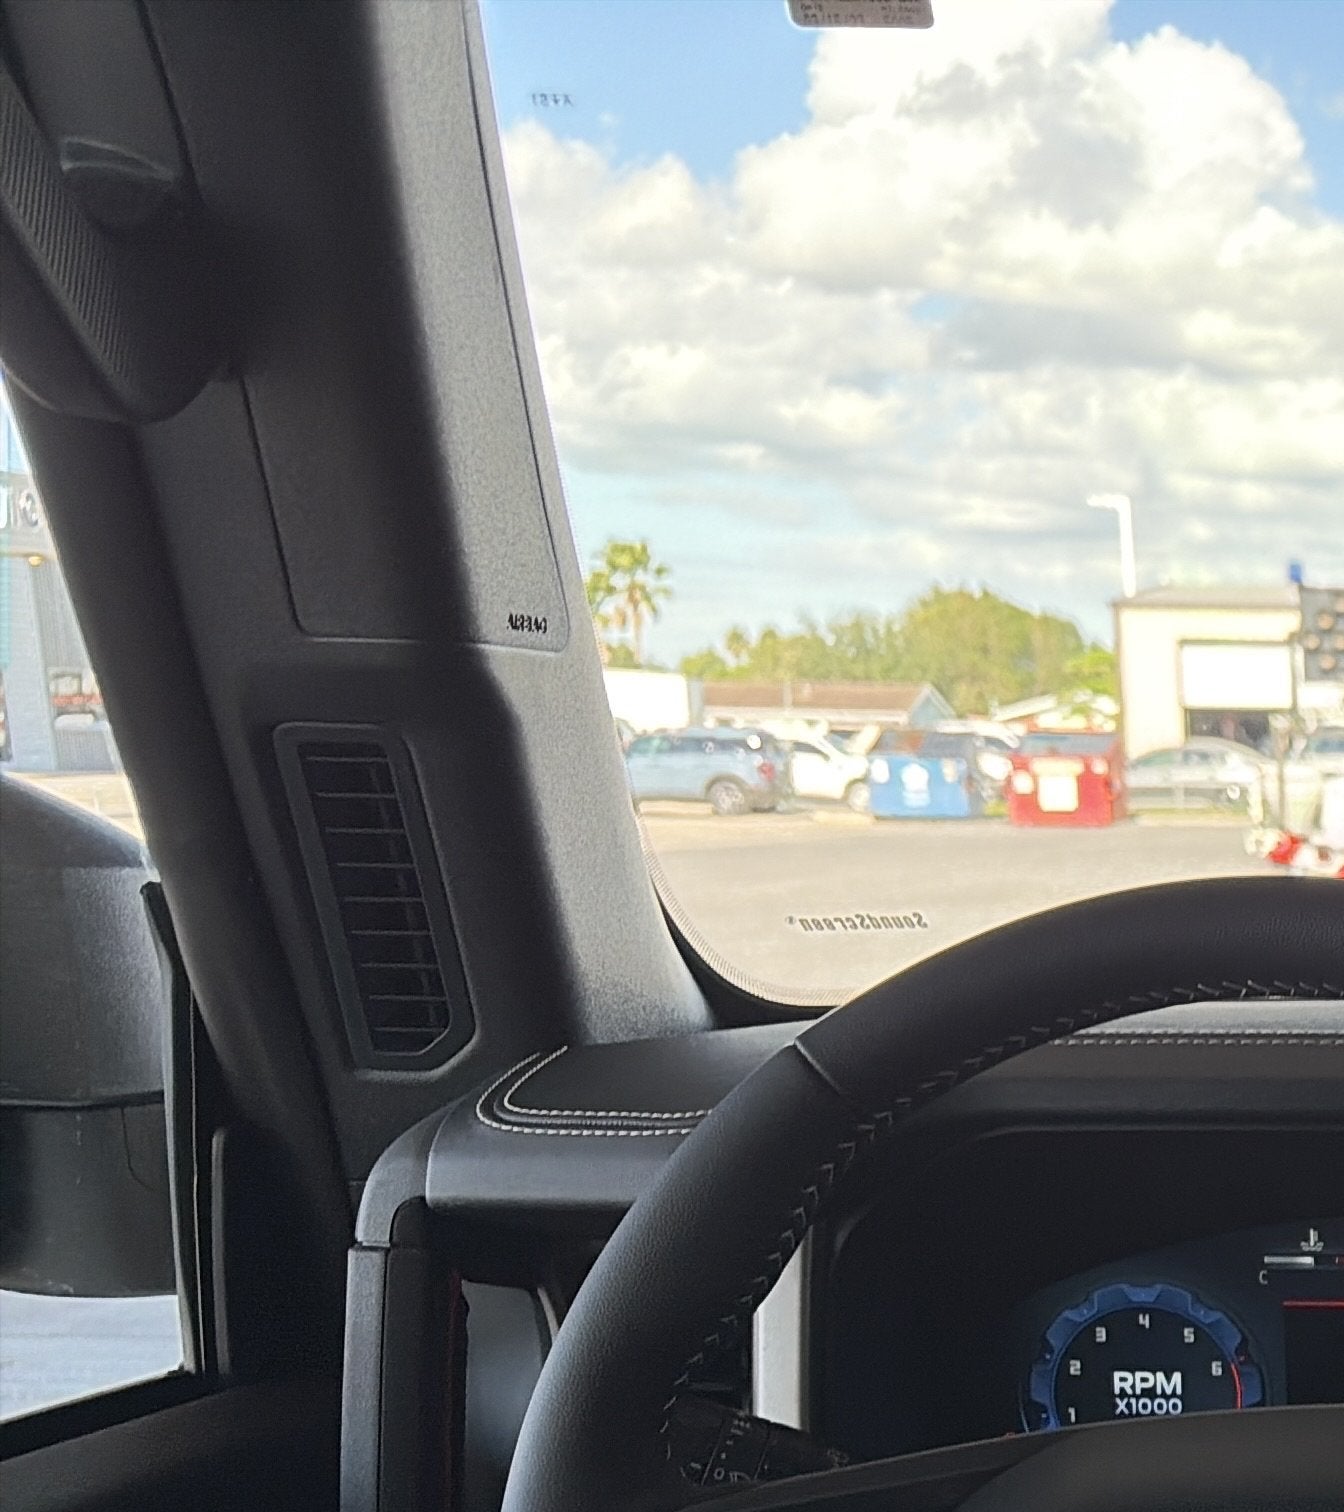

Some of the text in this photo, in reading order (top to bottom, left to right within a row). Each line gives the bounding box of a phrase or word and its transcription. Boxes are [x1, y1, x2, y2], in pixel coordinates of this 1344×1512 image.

[1258, 1272, 1268, 1285] C
[1138, 1313, 1150, 1330] 4
[1095, 1326, 1107, 1343] 3
[1183, 1326, 1195, 1344] 5
[1069, 1359, 1082, 1376] 2
[1211, 1361, 1223, 1377] 6
[1112, 1370, 1183, 1395] RPM
[1114, 1397, 1183, 1416] X1000
